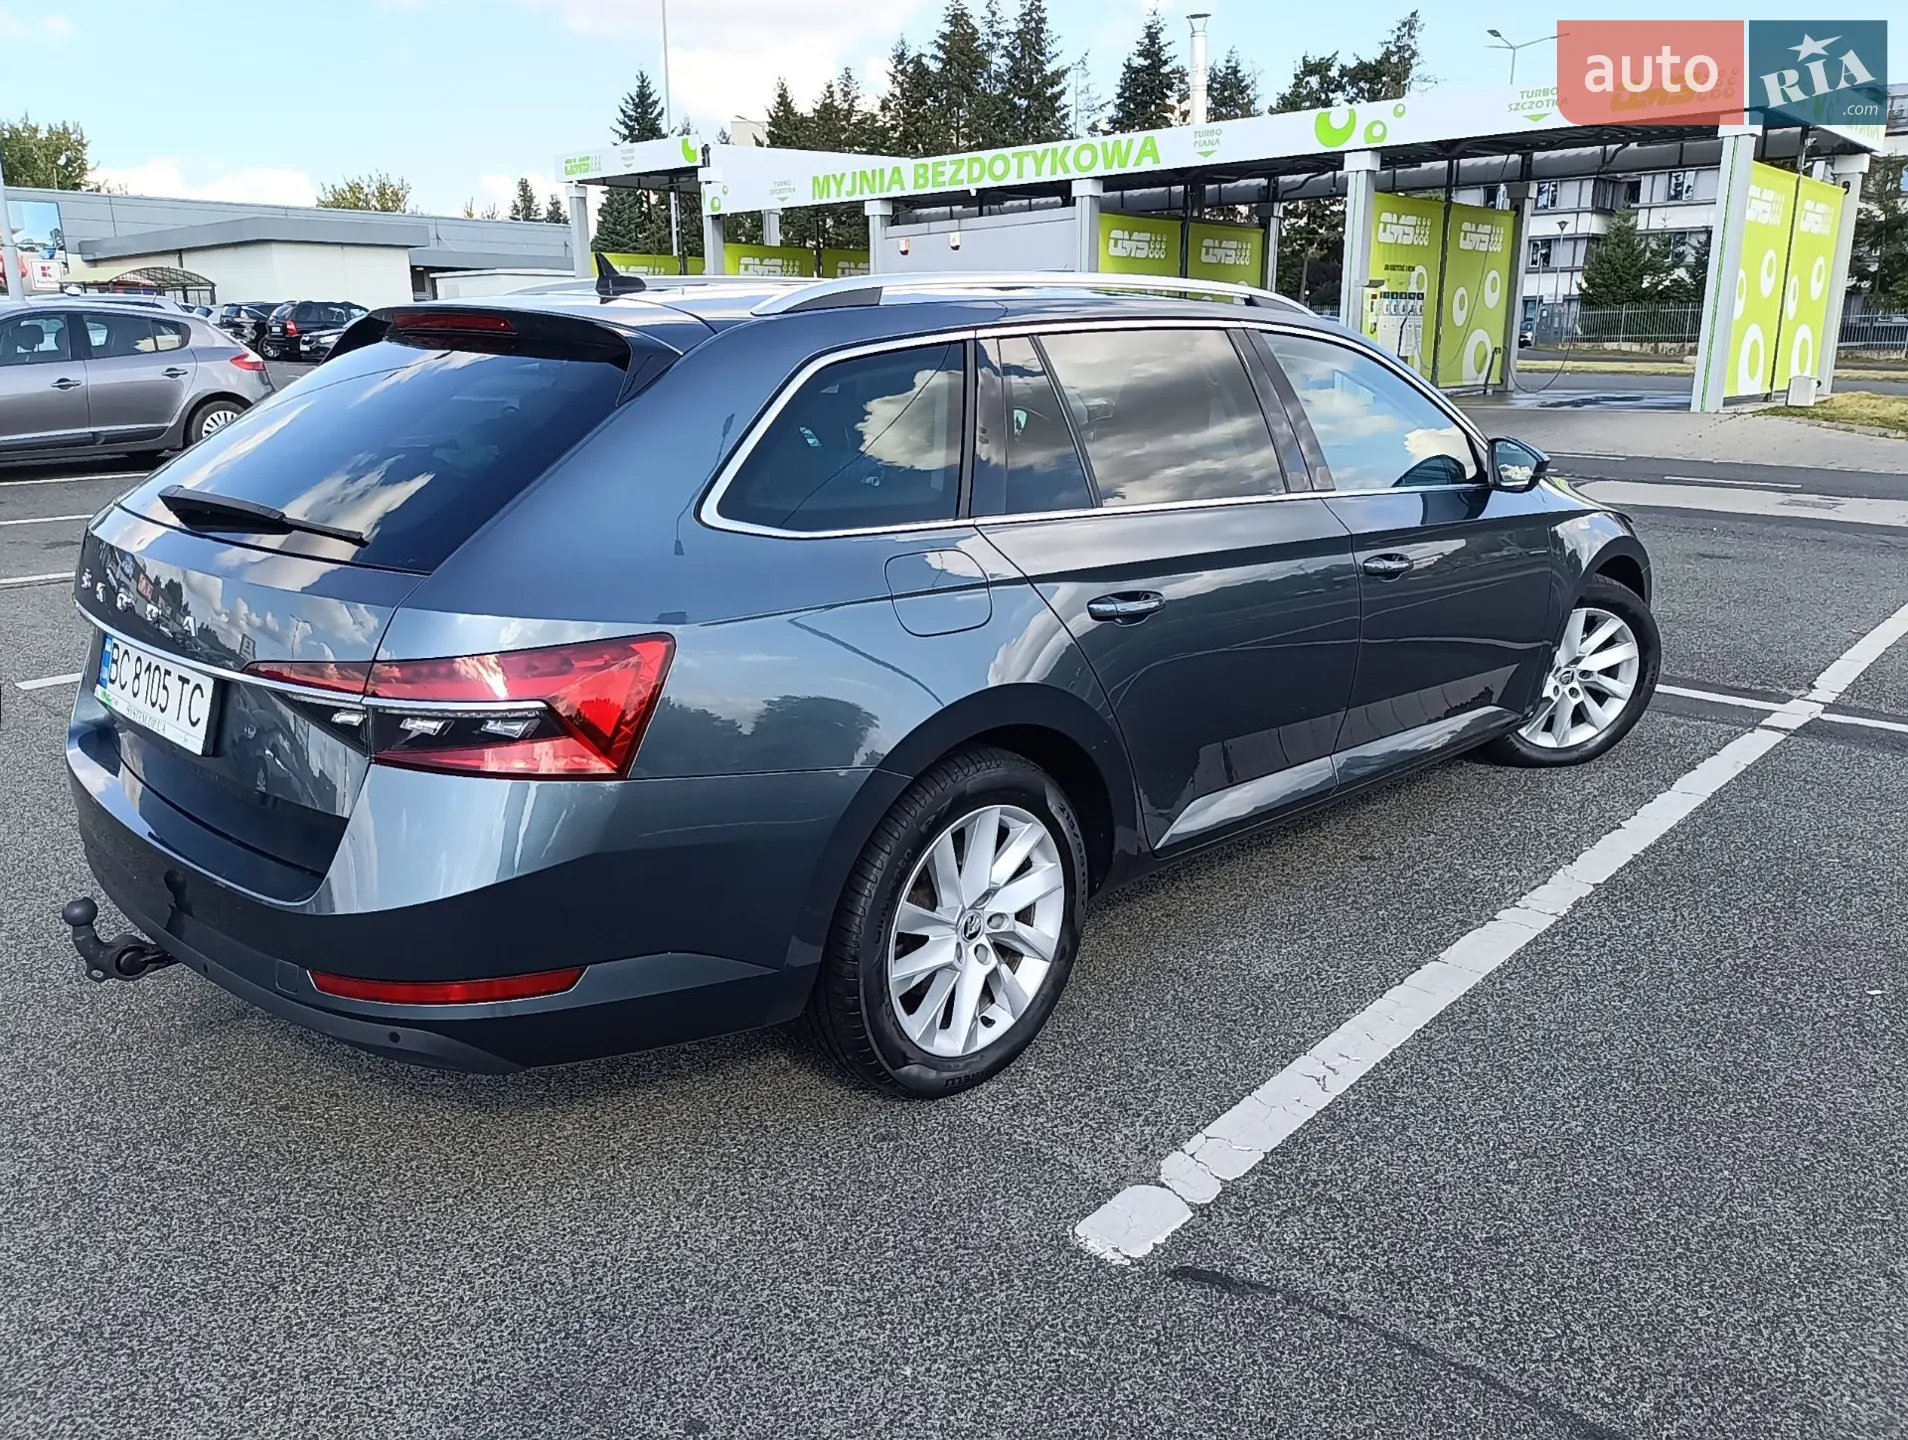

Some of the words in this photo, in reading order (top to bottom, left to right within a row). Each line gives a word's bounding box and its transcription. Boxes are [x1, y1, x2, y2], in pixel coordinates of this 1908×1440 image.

[1519, 86, 1559, 100] TURBO
[1193, 128, 1222, 139] TURBO
[1193, 138, 1221, 149] PIANA
[811, 166, 905, 201] MYJNIA
[912, 136, 1161, 190] BEZDOTYKOWA
[109, 642, 131, 691] BC
[132, 655, 172, 714] 8105
[176, 674, 204, 728] TC
